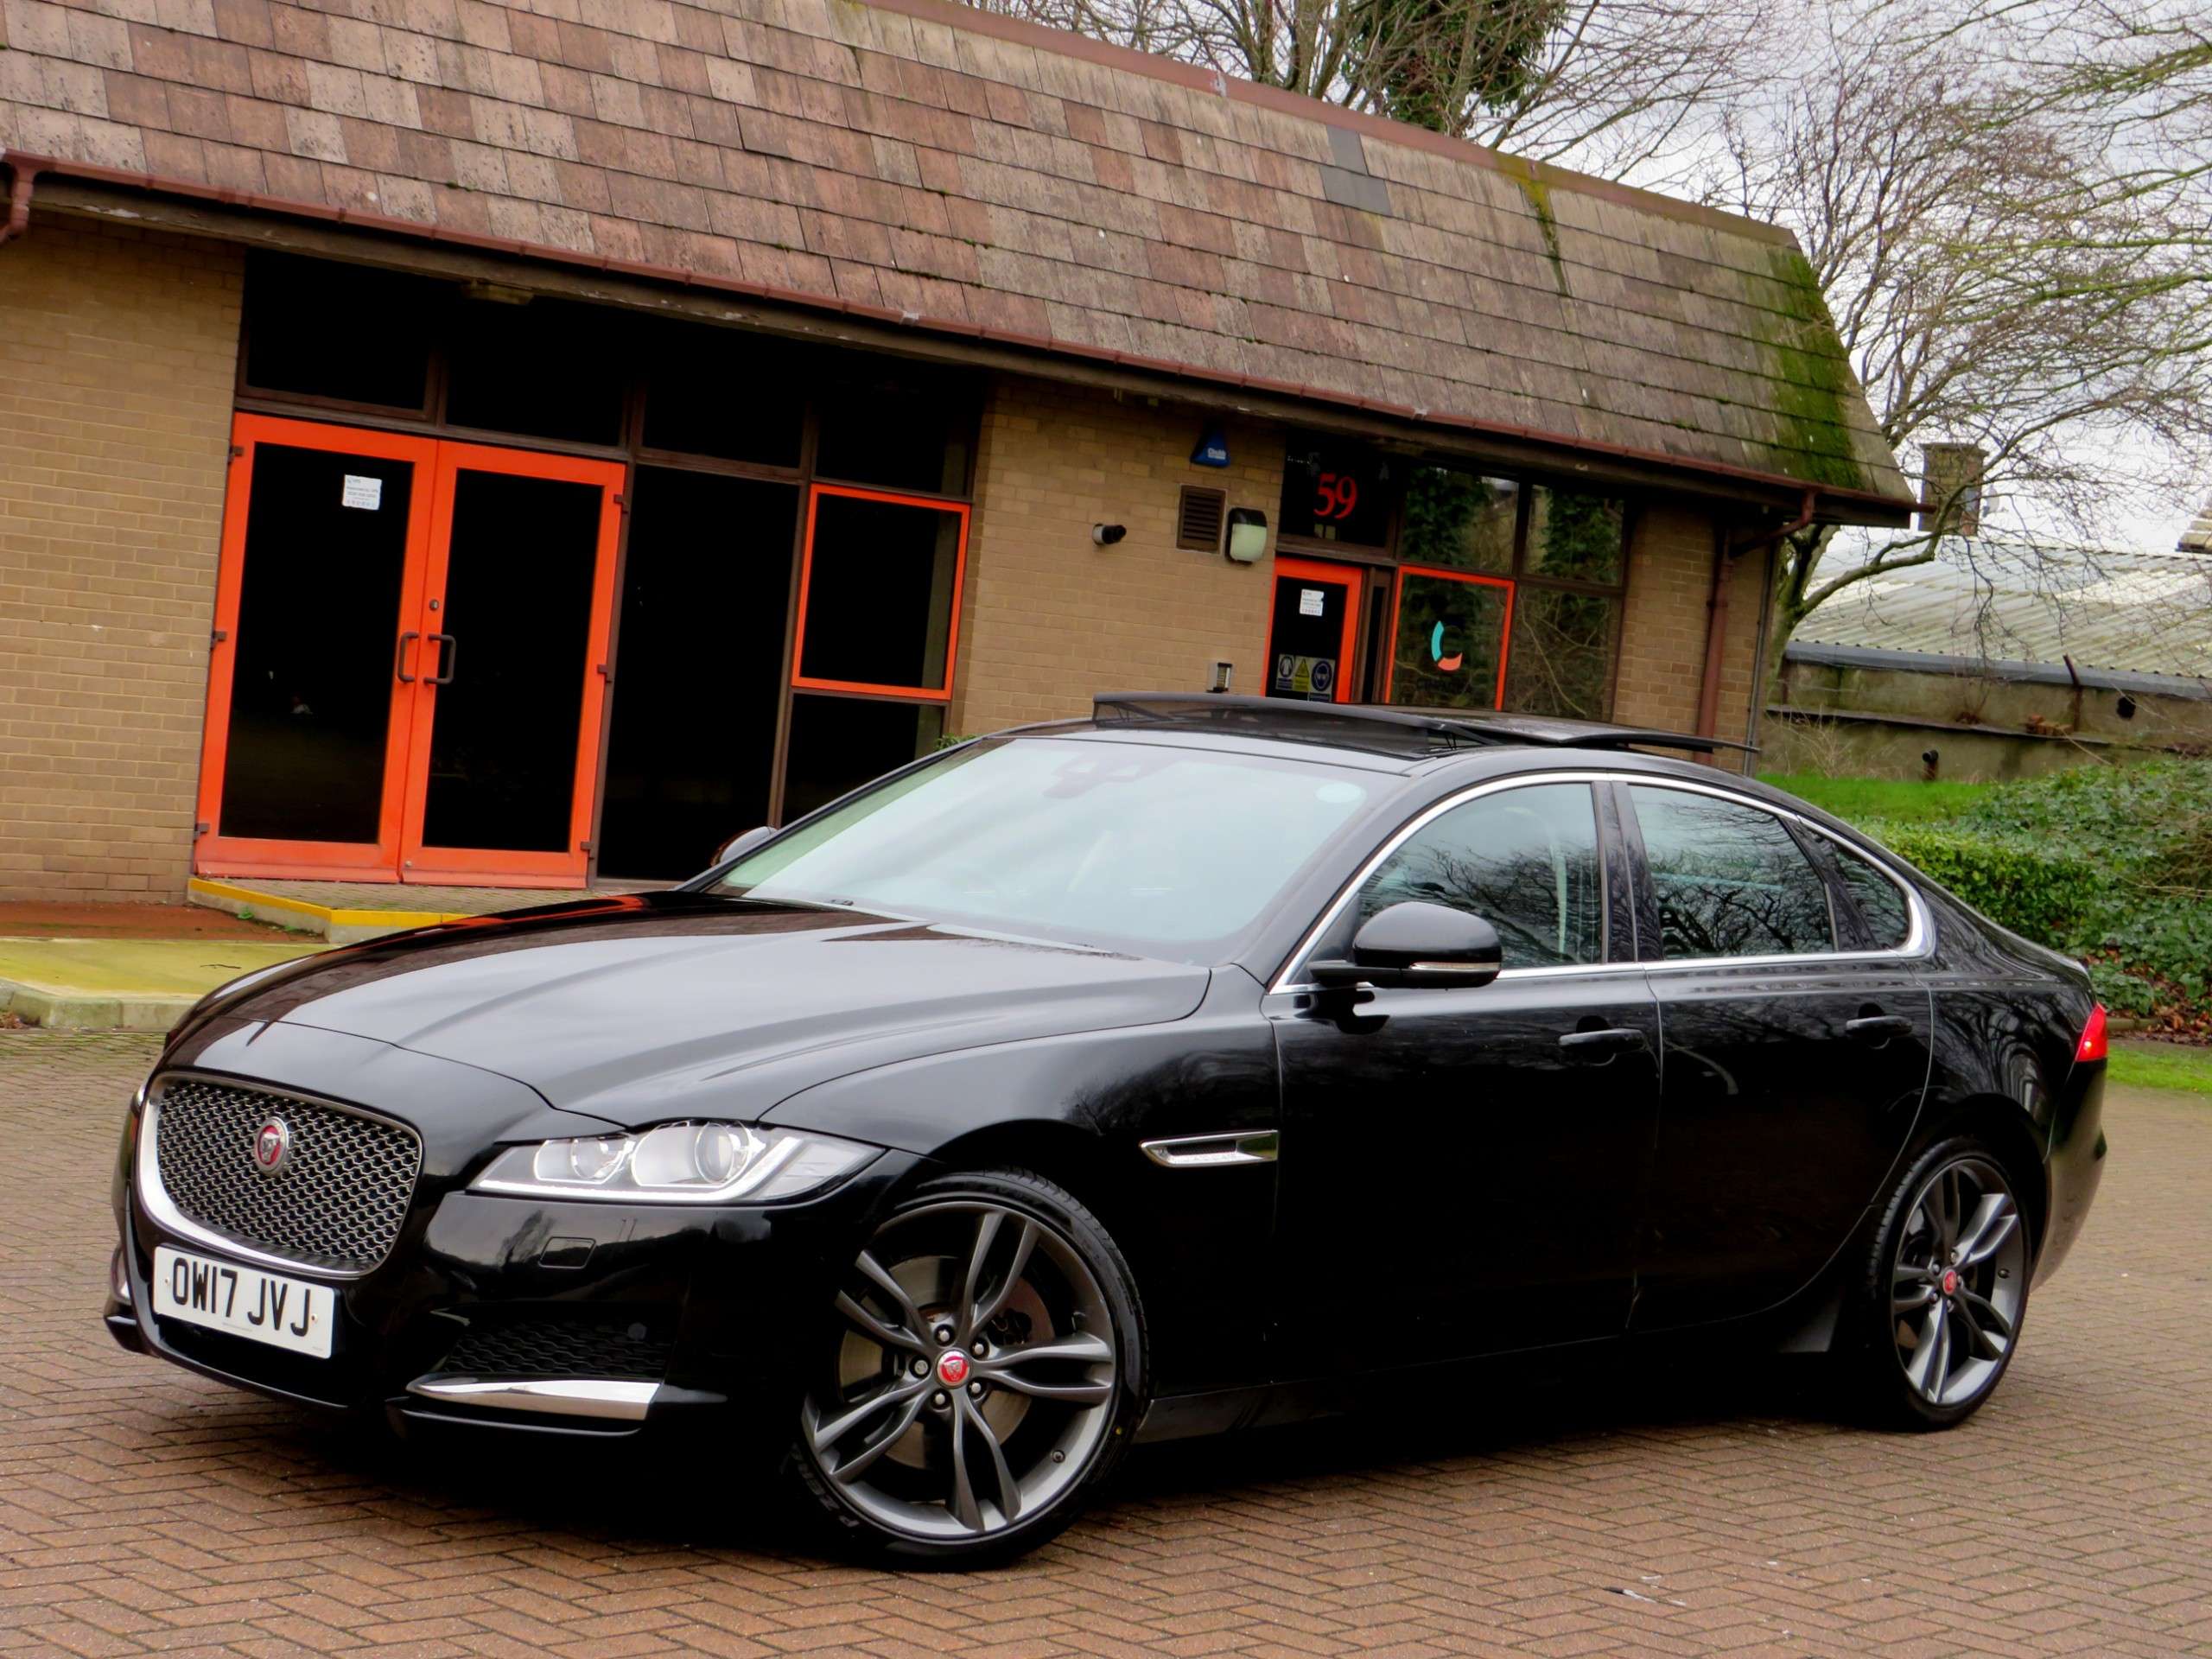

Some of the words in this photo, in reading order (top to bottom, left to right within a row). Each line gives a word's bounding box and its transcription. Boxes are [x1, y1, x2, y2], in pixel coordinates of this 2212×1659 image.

[1313, 473, 1357, 519] 59
[173, 1257, 238, 1318] OW17
[247, 1278, 311, 1337] JVJ
